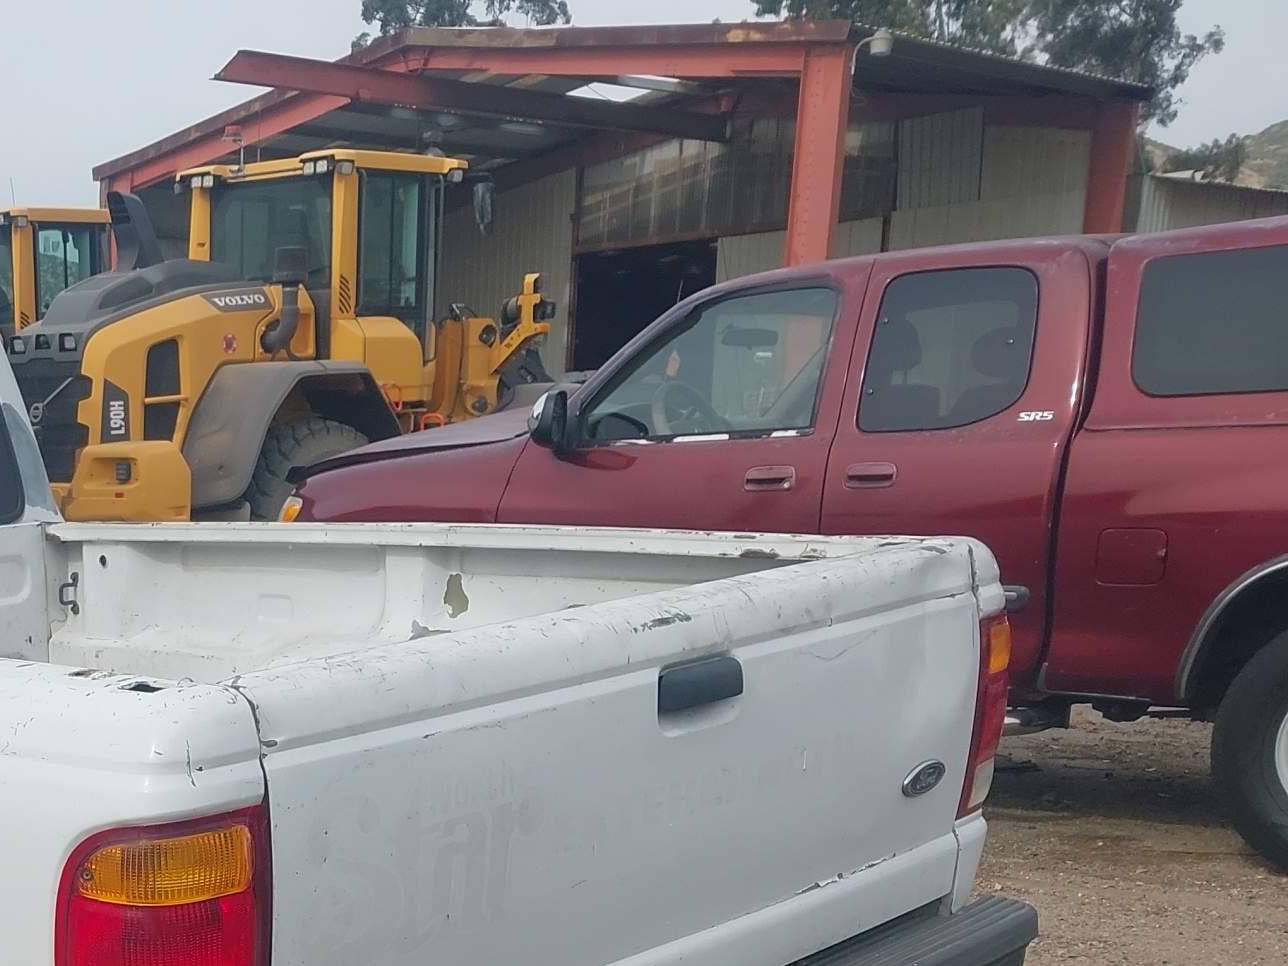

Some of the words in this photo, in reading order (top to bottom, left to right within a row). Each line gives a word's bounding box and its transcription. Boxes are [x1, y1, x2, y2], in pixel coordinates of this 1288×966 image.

[213, 294, 265, 307] VOLVO
[109, 400, 125, 435] L90H
[1017, 410, 1055, 422] SR5
